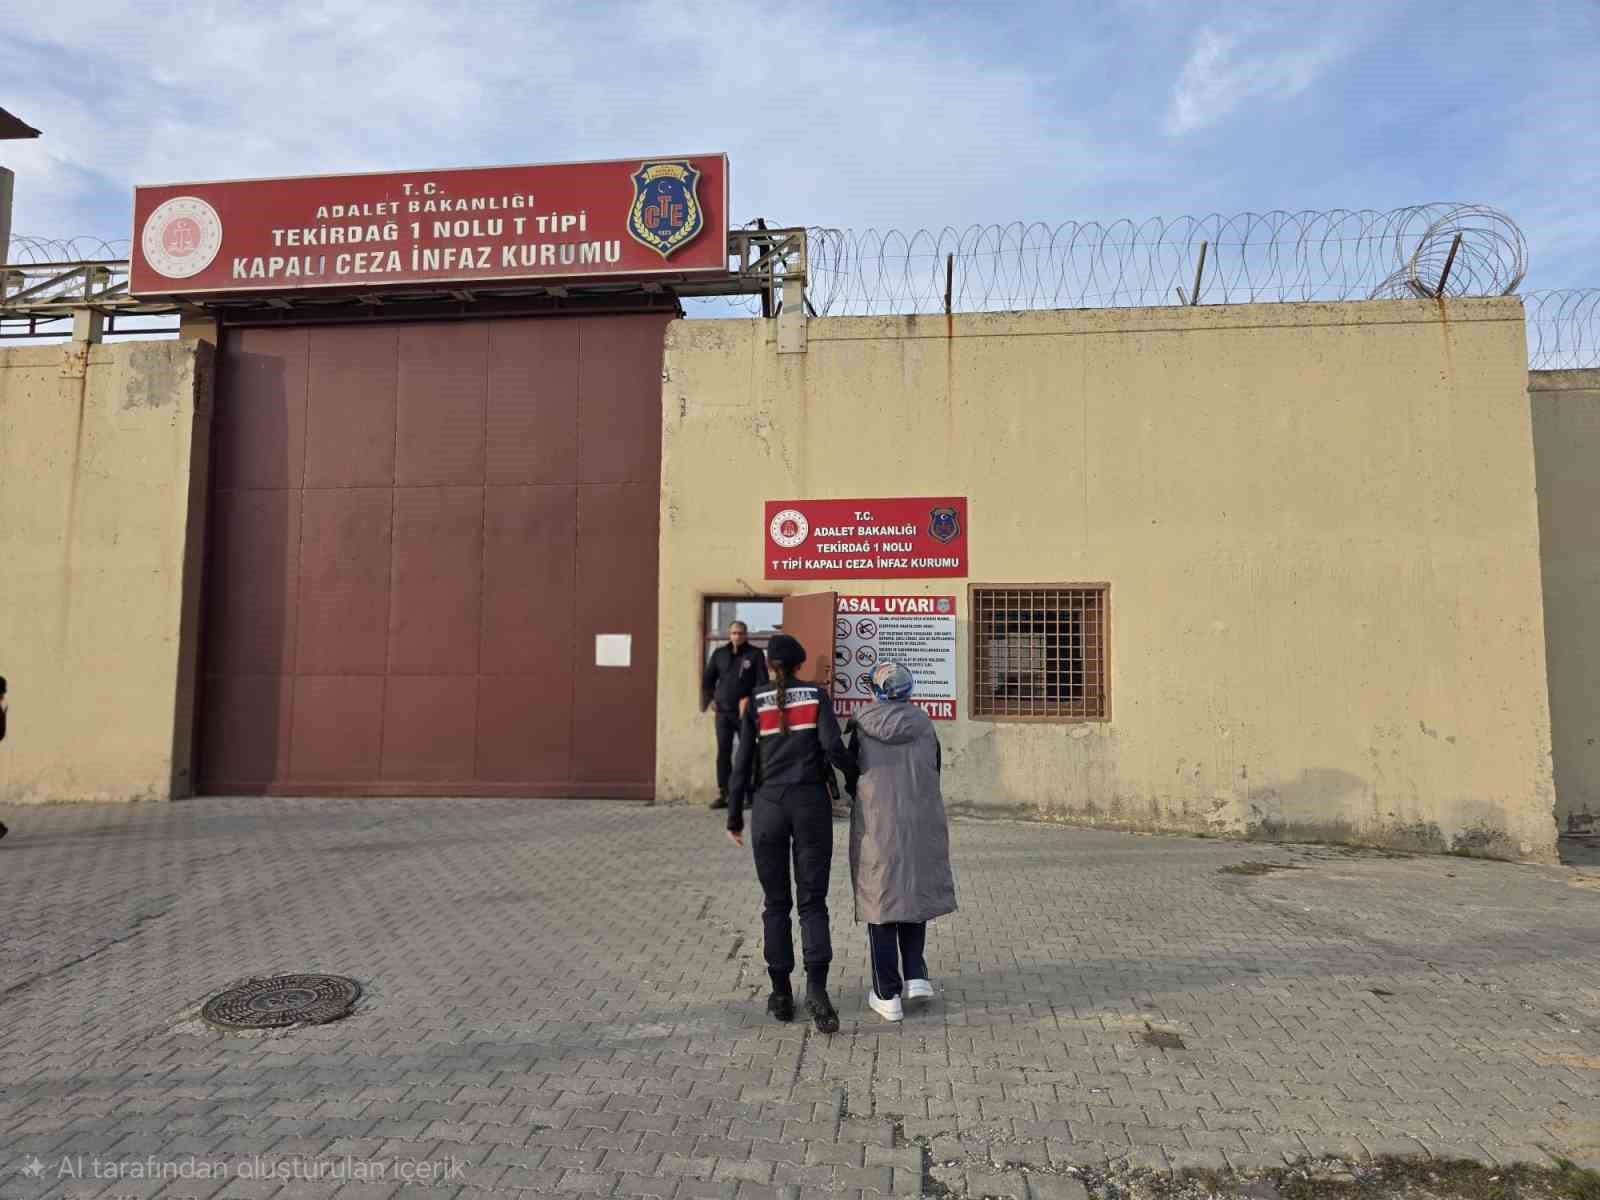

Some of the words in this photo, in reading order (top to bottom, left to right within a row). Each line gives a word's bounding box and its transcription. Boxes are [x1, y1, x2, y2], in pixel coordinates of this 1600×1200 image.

[403, 182, 445, 196] T.C.
[316, 201, 400, 219] ADALET
[408, 193, 535, 213] BAKANLIĞI
[271, 220, 399, 247] TEKİRDAĞ
[410, 222, 420, 239] 1
[433, 218, 503, 238] NOLU
[513, 217, 527, 235] T
[535, 210, 587, 234] TİPİ
[232, 255, 326, 279] KAPALI
[335, 250, 402, 275] CEZA
[412, 244, 492, 271] İNFAZ
[502, 240, 621, 267] KURUMU
[854, 511, 874, 521] T.C.
[814, 526, 855, 537] ADALET
[858, 523, 917, 536] BAKANLIĞI
[816, 540, 870, 553] TEKİRDAĞ
[874, 543, 879, 552] 1
[882, 542, 913, 552] NOLU
[772, 560, 780, 570] T
[781, 557, 802, 570] TİPİ
[805, 559, 843, 569] KAPALI
[846, 559, 874, 569] CEZA
[876, 555, 908, 568] İNFAZ
[911, 558, 960, 568] KURUMU
[836, 598, 880, 612] ASAL
[885, 598, 934, 612] UYARI
